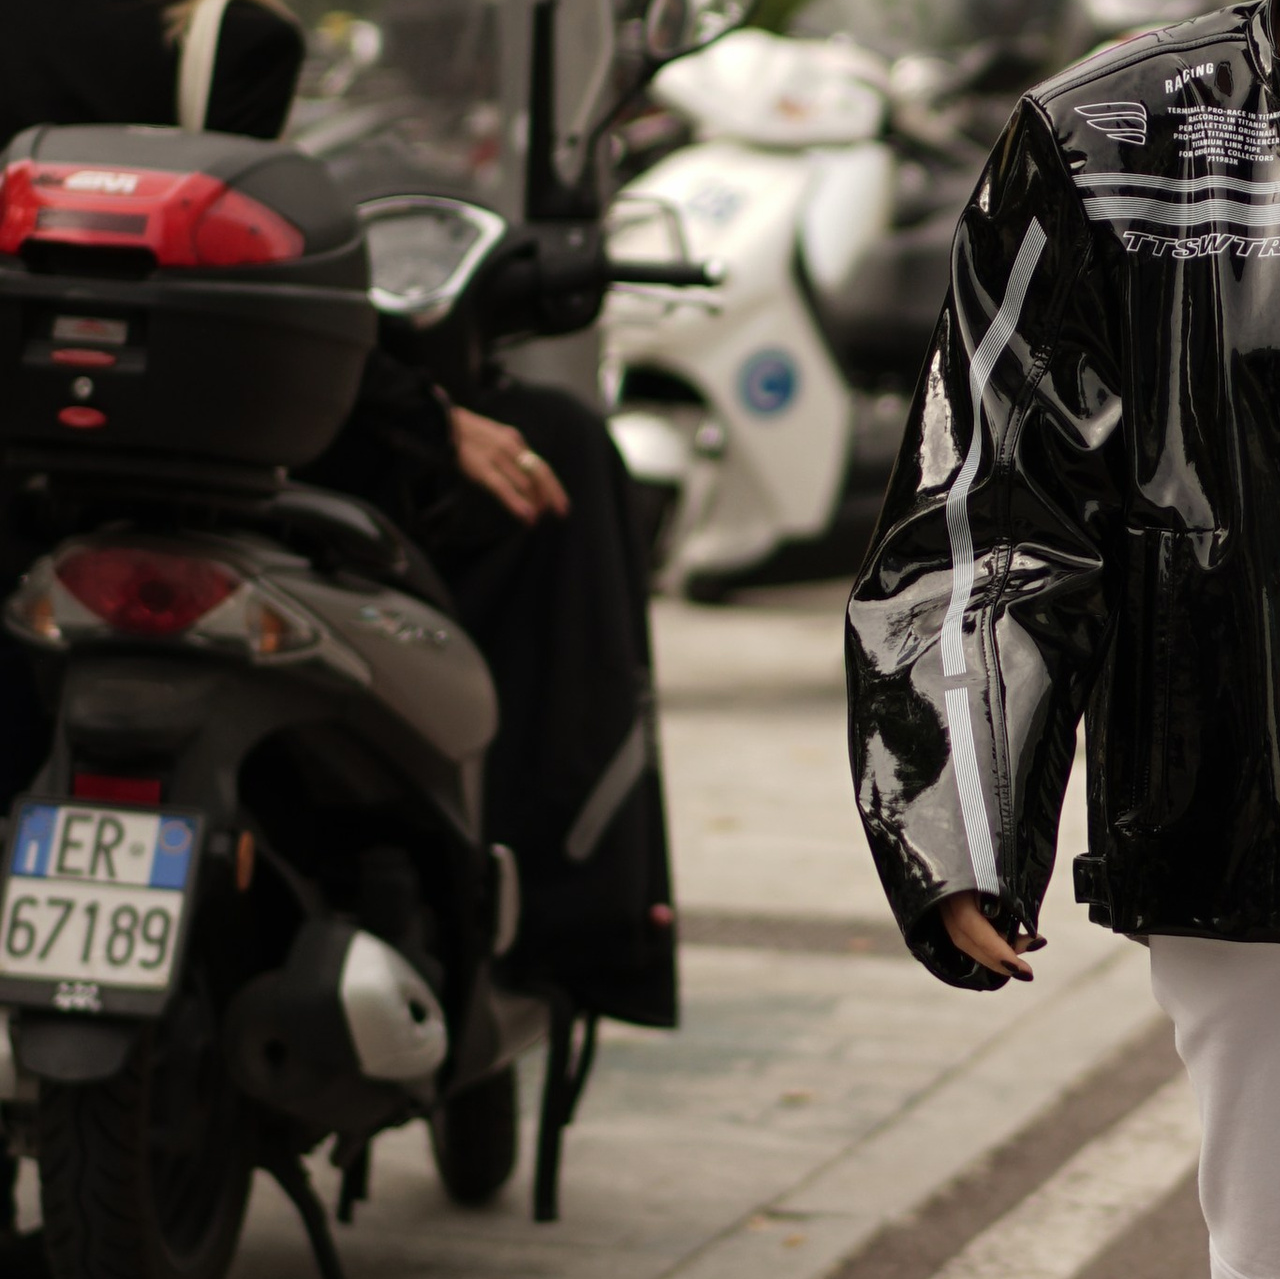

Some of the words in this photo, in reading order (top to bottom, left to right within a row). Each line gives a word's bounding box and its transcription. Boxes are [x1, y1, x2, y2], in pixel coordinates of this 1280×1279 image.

[1165, 63, 1214, 94] RACING
[1207, 106, 1247, 117] PRO-RACE
[1248, 112, 1256, 120] IN
[1179, 124, 1193, 132] PER
[1194, 121, 1236, 132] COLLETTORI
[1238, 127, 1276, 137] ORIGINALI
[1226, 116, 1236, 124] IN
[1238, 118, 1267, 129] TITANIO
[1207, 131, 1244, 141] TITANIUM
[1245, 137, 1280, 145] SILENCER
[1192, 139, 1223, 148] TITANIUM
[1225, 141, 1242, 149] LINK
[1244, 144, 1261, 153] PIPE
[1179, 150, 1193, 158] FOR
[1227, 149, 1274, 161] COLLECTORS
[55, 814, 126, 879] ER
[5, 894, 173, 970] 67189
